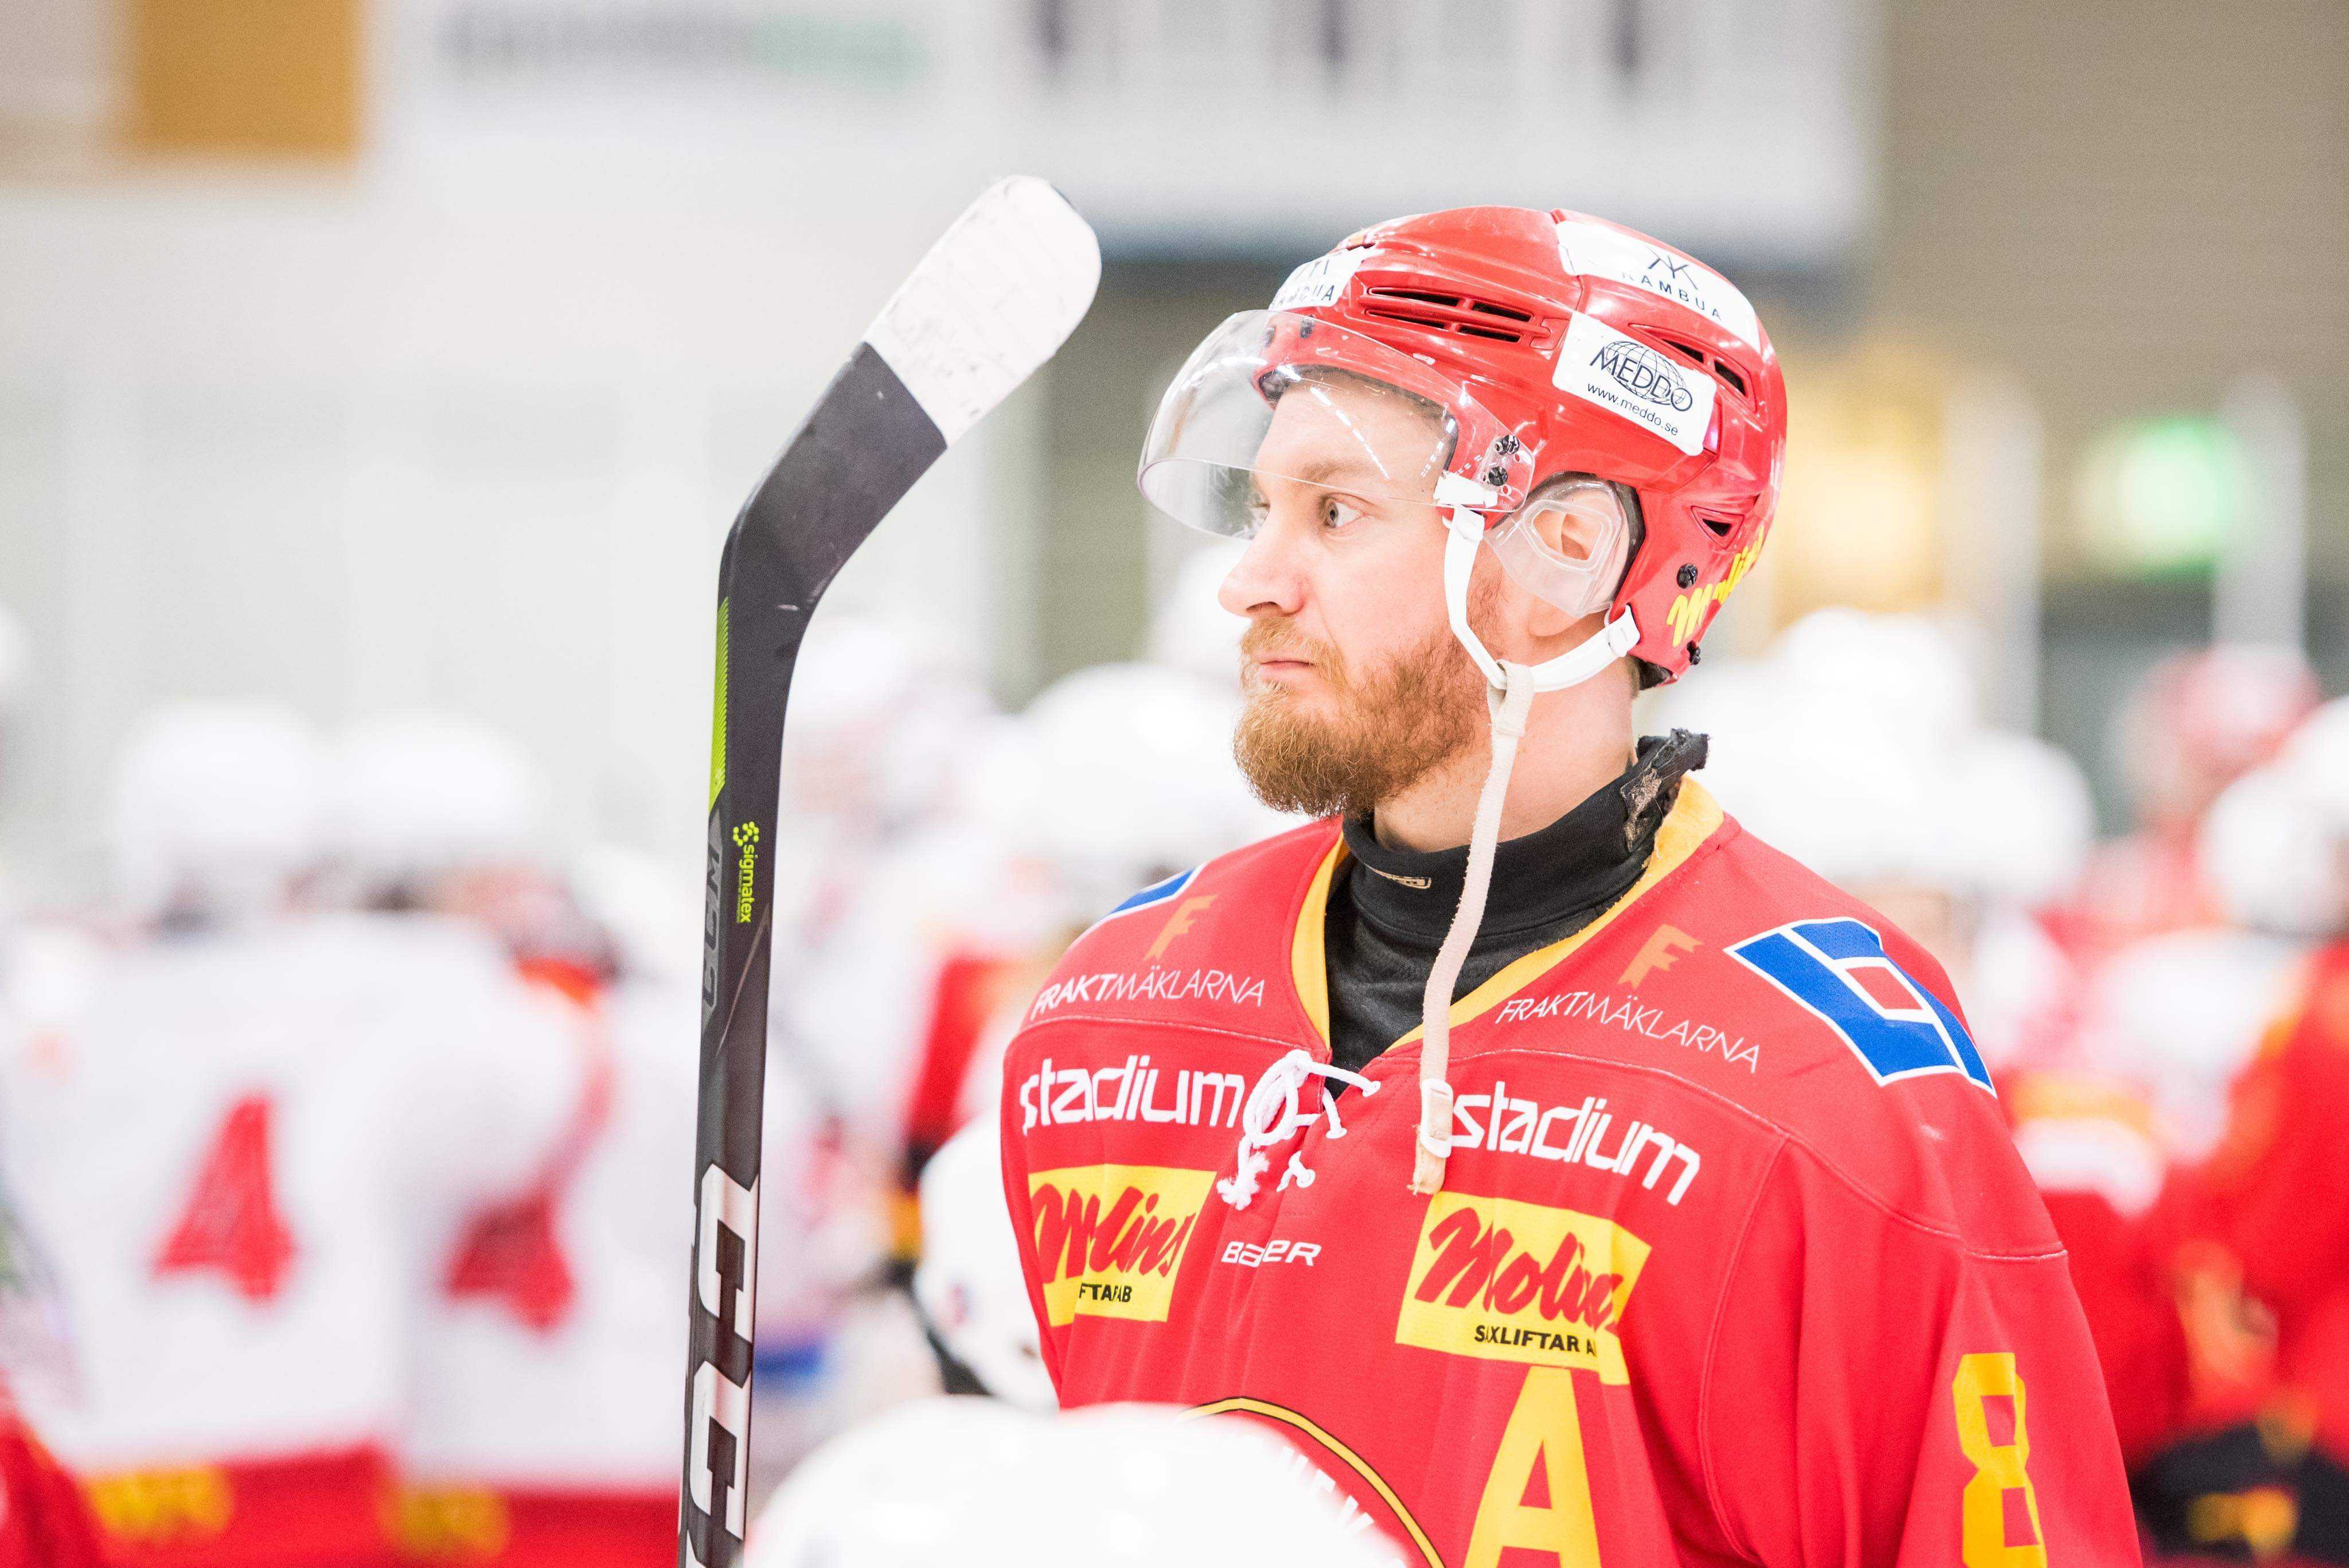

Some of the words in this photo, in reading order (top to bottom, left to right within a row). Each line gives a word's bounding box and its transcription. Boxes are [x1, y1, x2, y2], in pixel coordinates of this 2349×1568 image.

[1621, 271, 1722, 322] AMBUA
[1587, 383, 1678, 436] www.meddo.se
[1589, 346, 1692, 412] MEDDO
[739, 844, 758, 923] sigmatex
[1031, 965, 1265, 1020] FRAKTMÄKLARNA
[1495, 991, 1759, 1074] FRAKTMÄKLARNA
[1020, 1055, 1245, 1136] stadium
[1451, 1081, 1700, 1207] stadium
[1220, 1240, 1321, 1267] BAER
[684, 1163, 759, 1568] CC
[1474, 1325, 1581, 1352] SXLIFTAR
[1463, 1365, 1602, 1568] A
[1952, 1352, 2048, 1568] 8
